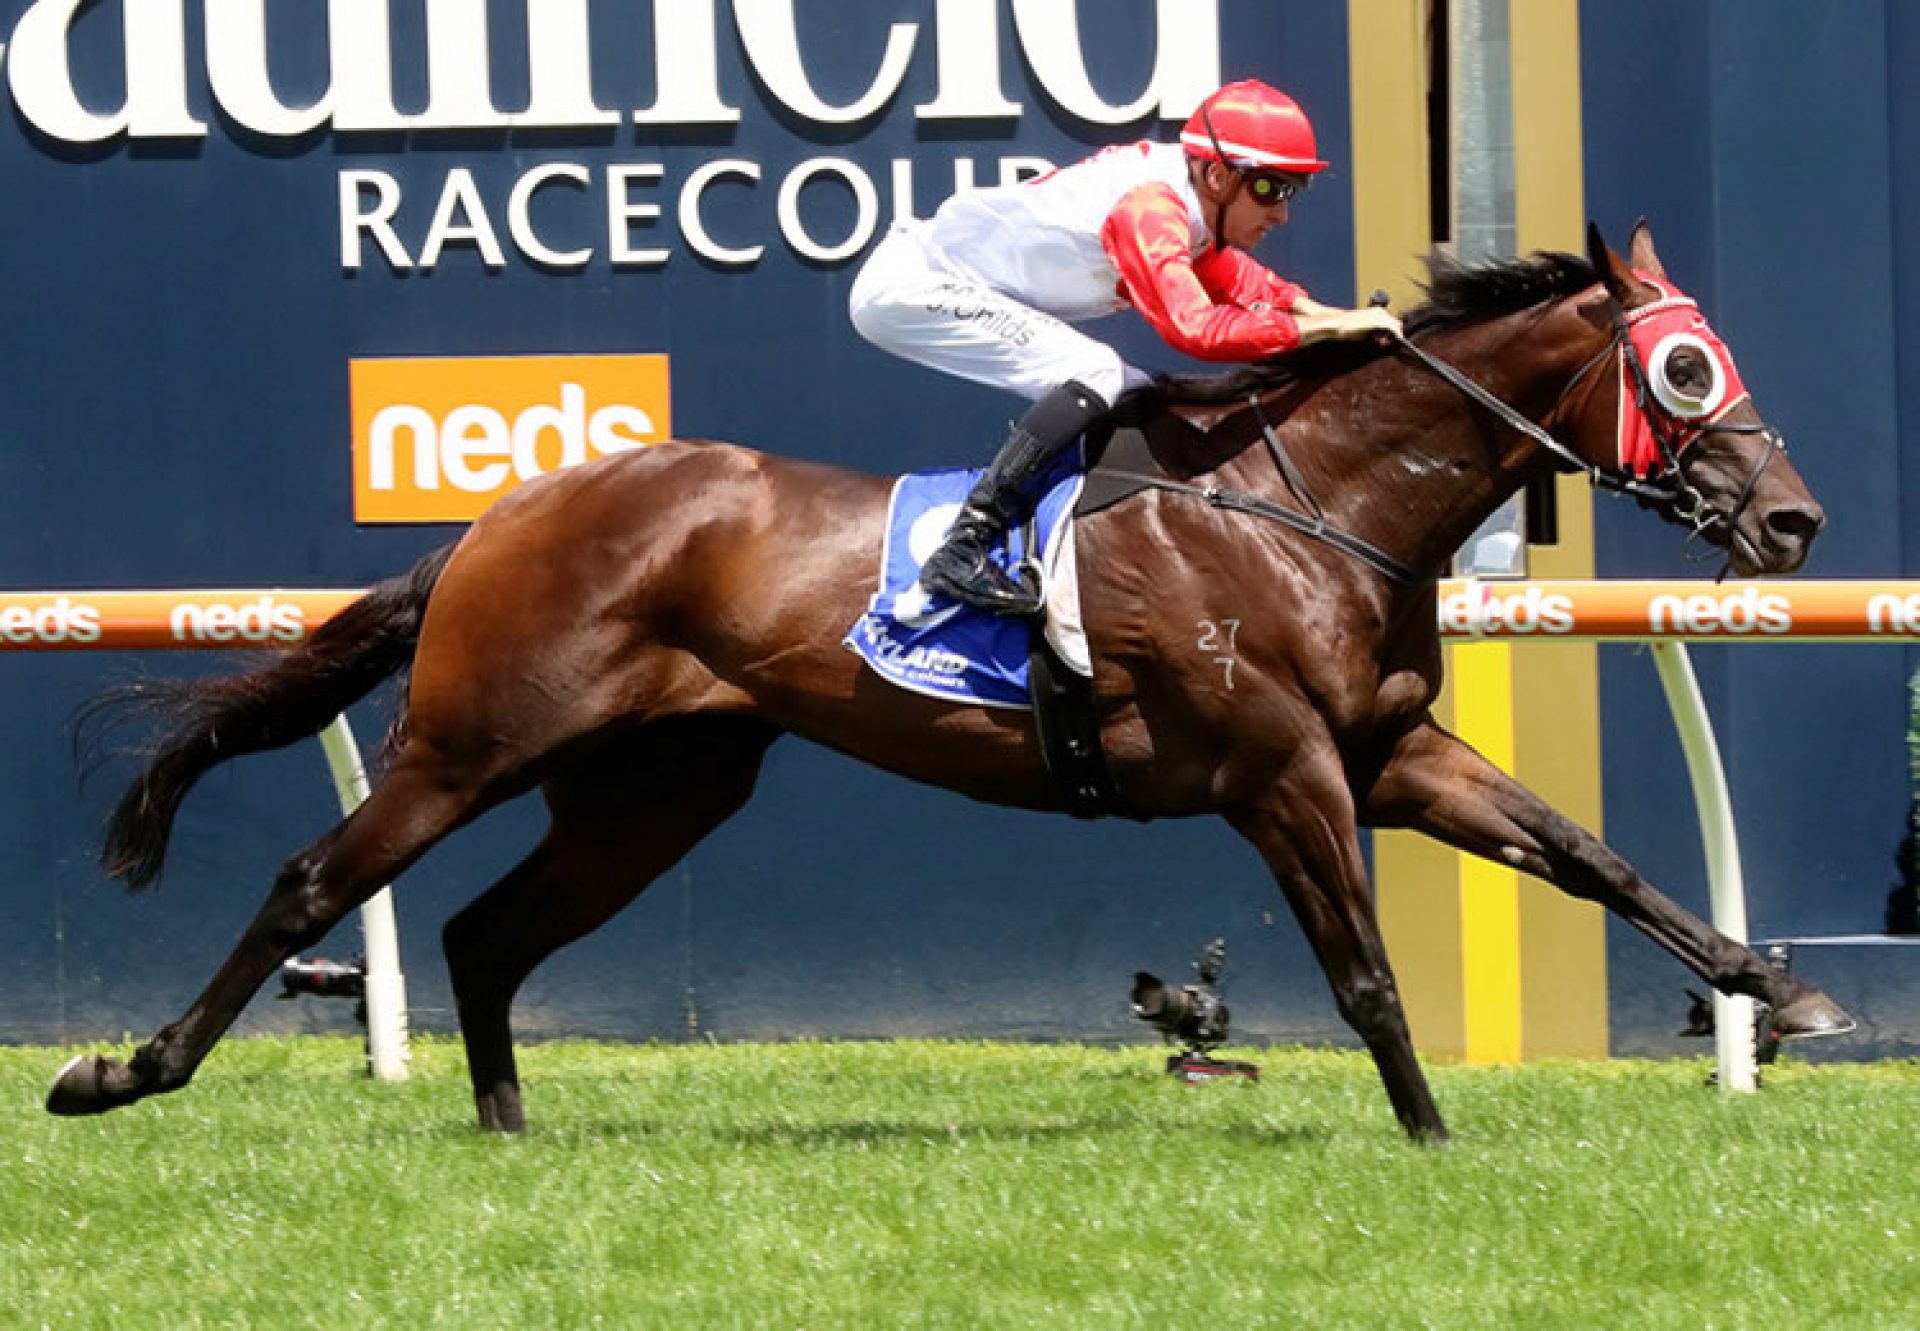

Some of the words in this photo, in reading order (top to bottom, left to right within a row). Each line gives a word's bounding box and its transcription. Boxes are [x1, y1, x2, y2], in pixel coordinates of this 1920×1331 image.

[0, 598, 102, 643] eds
[170, 596, 304, 642] neds
[1648, 587, 1792, 633] neds
[1197, 619, 1240, 651] 27
[1213, 657, 1235, 690] 7
